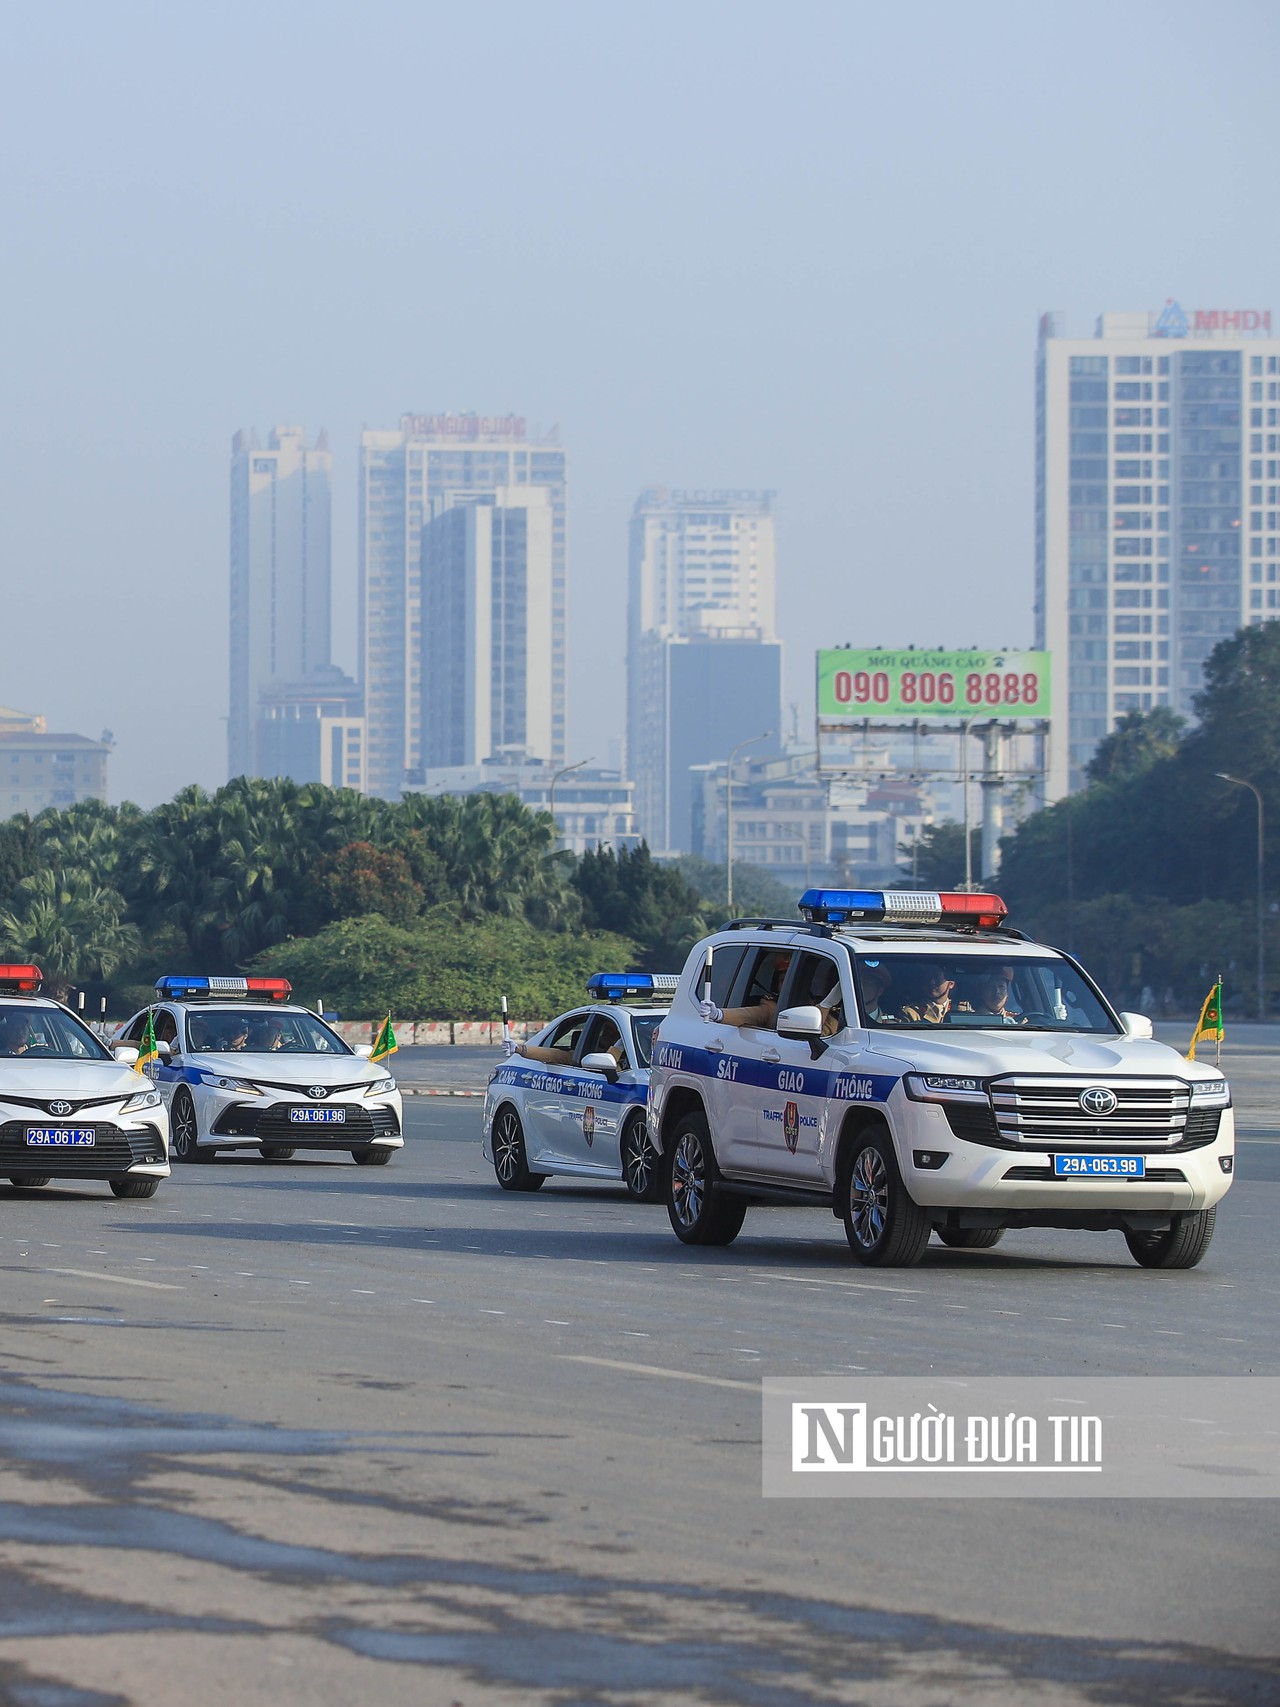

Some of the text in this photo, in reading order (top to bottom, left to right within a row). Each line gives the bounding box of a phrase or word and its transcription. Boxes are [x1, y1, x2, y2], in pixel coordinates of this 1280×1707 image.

[1194, 309, 1271, 331] MHDI
[835, 671, 1039, 705] 090 806 8888
[531, 1072, 545, 1090] SÁT
[545, 1076, 563, 1093] GIAO
[717, 1056, 739, 1081] SÁT
[778, 1070, 805, 1093] GIAO
[835, 1074, 873, 1099] THÔNG
[292, 1109, 344, 1122] 29A-061.96
[762, 1109, 818, 1128] TRAFFIC POLICE
[28, 1129, 94, 1145] 29A-061.29
[1062, 1157, 1138, 1174] 29A-063.98
